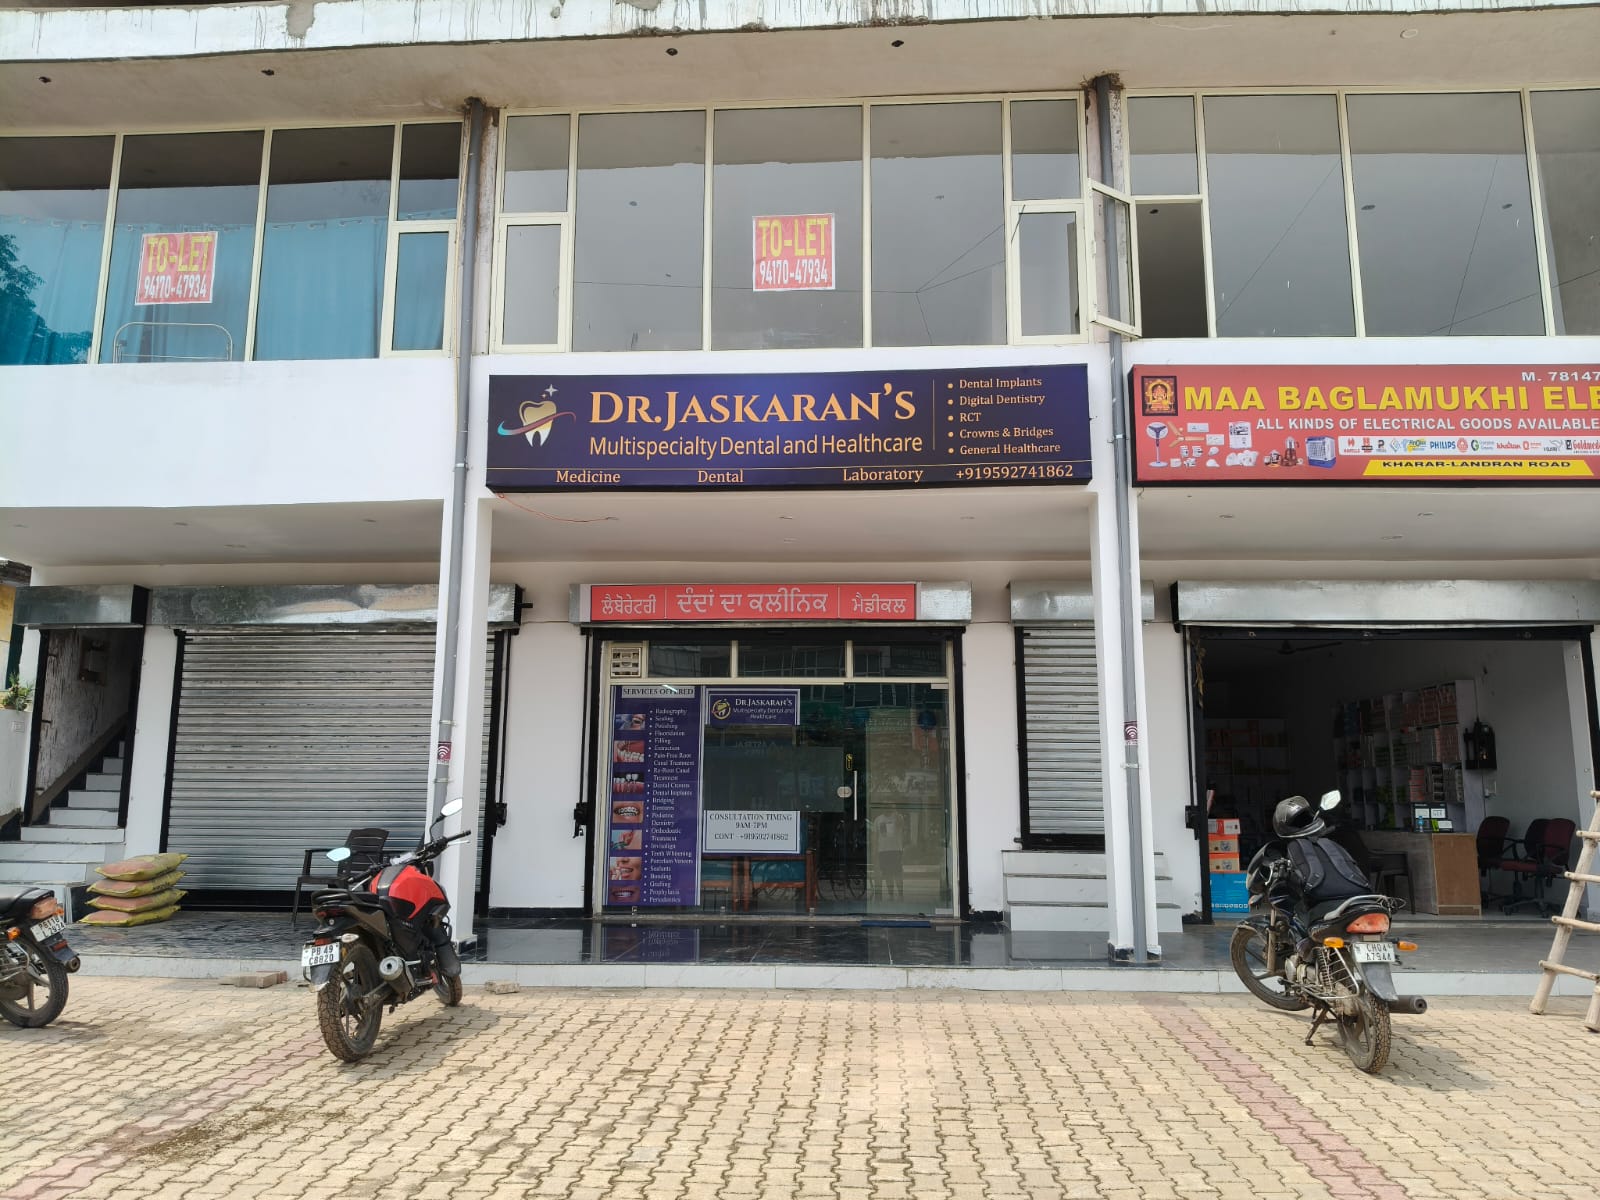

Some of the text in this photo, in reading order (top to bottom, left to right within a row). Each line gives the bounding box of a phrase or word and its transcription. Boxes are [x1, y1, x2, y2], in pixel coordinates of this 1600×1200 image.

[758, 217, 829, 257] TO-LET
[147, 235, 213, 273] TO-LET
[759, 258, 829, 285] 94170-47934
[143, 274, 207, 299] 94170-47934
[959, 377, 1043, 390] Dental Implants
[1521, 371, 1543, 382] M.
[959, 394, 1046, 407] Digital Dentistry
[1184, 386, 1265, 411] MAA
[1278, 386, 1530, 411] BAGLAMUKHI
[589, 382, 916, 431] DR.JASKARAN'S
[959, 412, 982, 423] RCT
[1256, 418, 1600, 430] ALL KINDS OF ELECTRICAL GOODS AVAILABLE
[959, 427, 1054, 439] Crowns & Bridges
[589, 433, 923, 461] Multispecialty Dental and Healthcare
[959, 443, 1061, 455] General Healthcare
[1429, 441, 1456, 449] PHILIPS
[556, 470, 621, 483] Medicine
[697, 469, 744, 483] Dental
[842, 468, 924, 483] Laboratory
[956, 464, 1074, 480] +919592741862
[601, 593, 657, 614] ਲੈਬੋਰੇਟਰੀ
[676, 587, 829, 613] ਦੰਦਾਂ ਦਾ ਕਲੀਨਿਕ
[851, 591, 907, 613] ਮੈਡੀਕਲ
[709, 813, 792, 821] CONSULTATION TIMING
